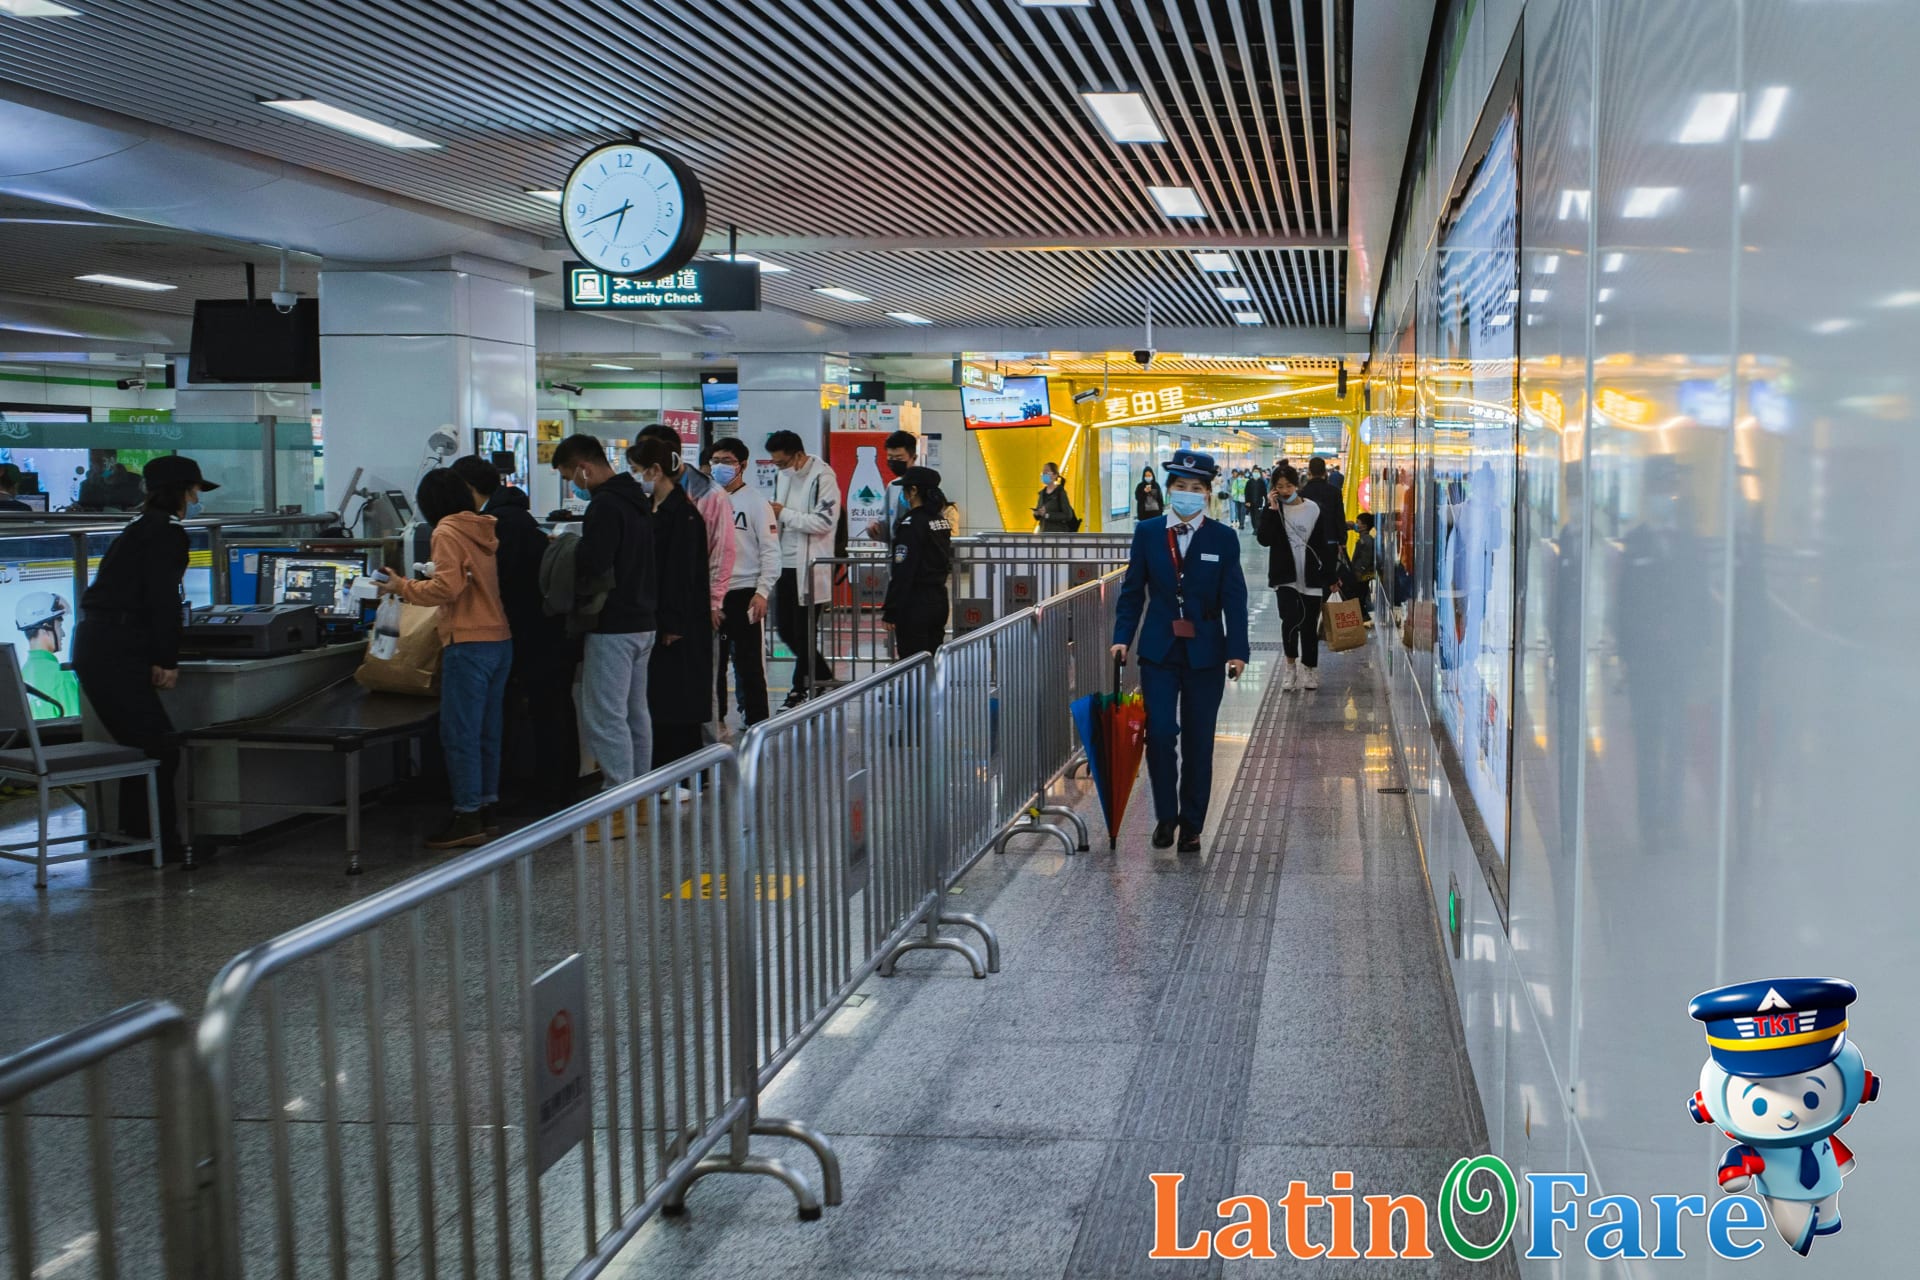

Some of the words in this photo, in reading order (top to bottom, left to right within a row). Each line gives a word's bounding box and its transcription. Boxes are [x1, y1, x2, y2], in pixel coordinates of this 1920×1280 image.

[617, 153, 633, 168] 12
[577, 203, 587, 218] 9
[665, 202, 674, 217] 3
[620, 252, 630, 268] 6
[612, 292, 662, 306] Security
[664, 292, 703, 304] Check
[1104, 386, 1185, 420] 麦田里
